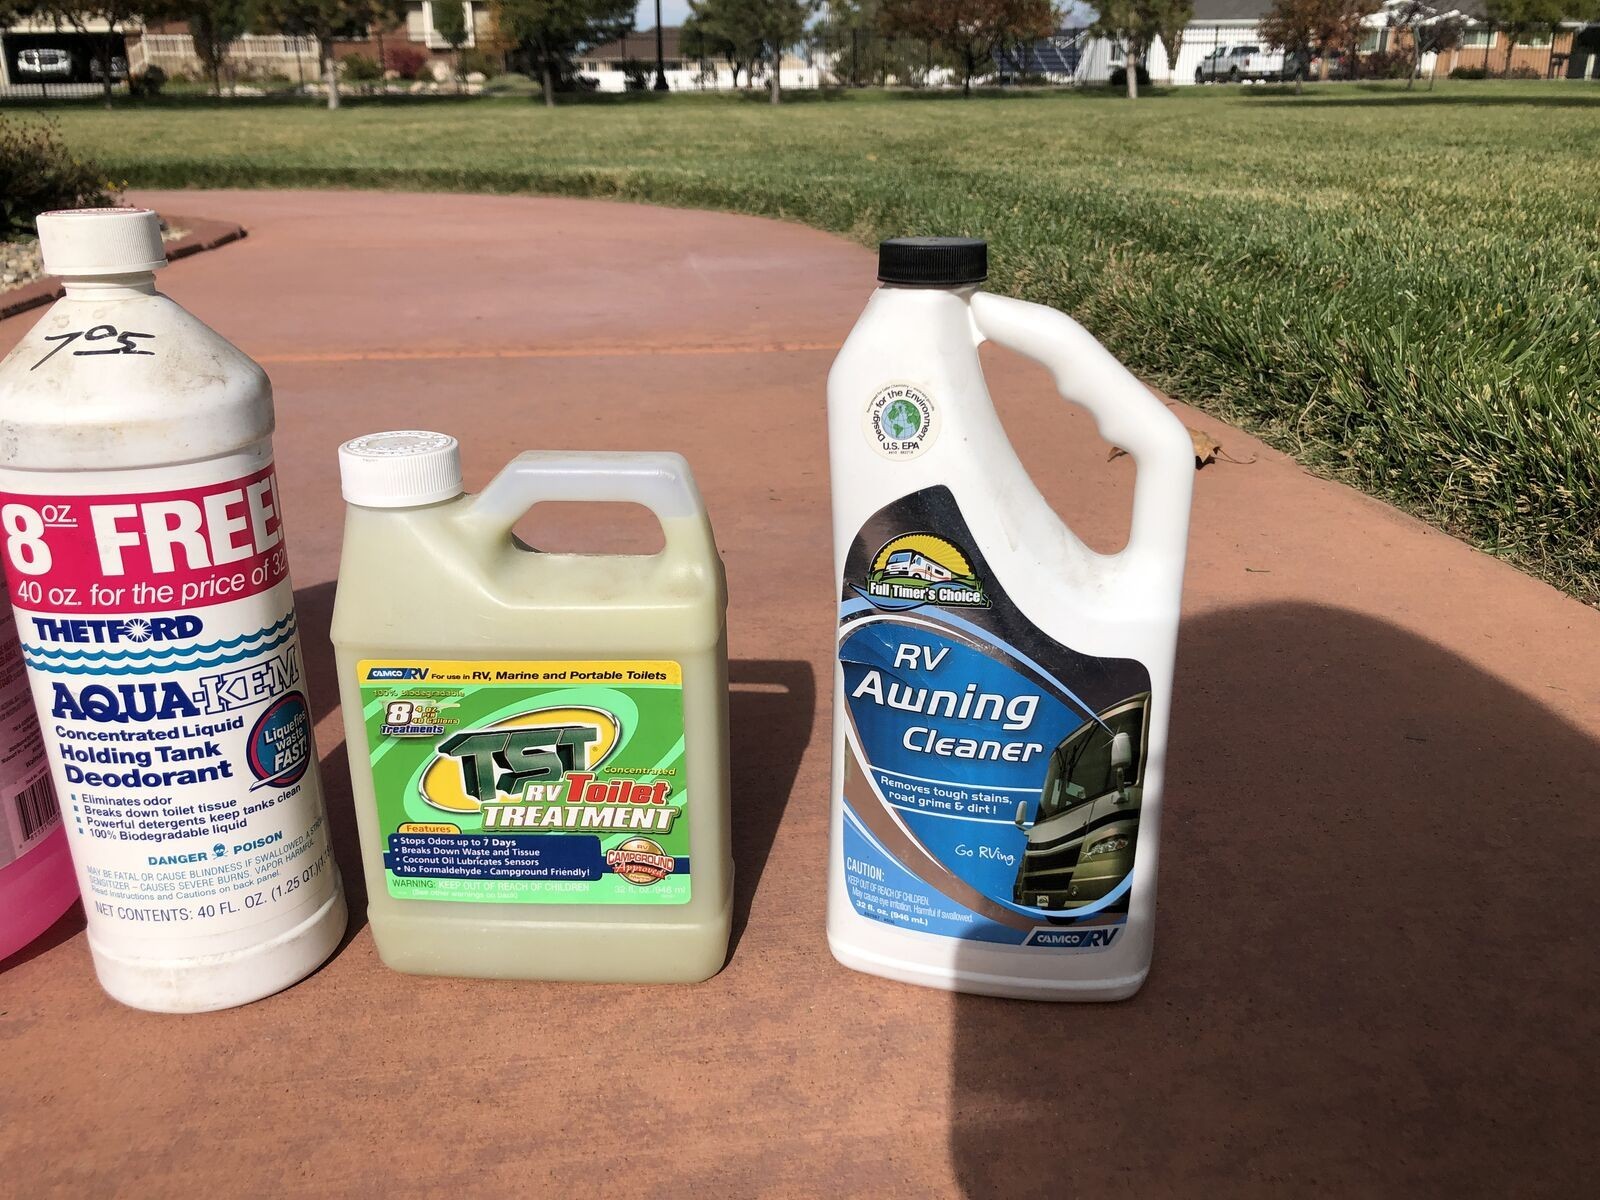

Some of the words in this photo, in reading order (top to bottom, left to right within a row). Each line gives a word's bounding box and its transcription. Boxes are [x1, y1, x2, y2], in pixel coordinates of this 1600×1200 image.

[876, 396, 887, 408] for
[887, 390, 903, 399] the
[871, 410, 886, 442] Design
[905, 389, 931, 442] Environment
[883, 442, 900, 450] U.S.
[902, 442, 919, 450] EPA
[1, 503, 53, 576] 8
[17, 580, 42, 604] 40
[48, 586, 82, 606] oz.
[90, 583, 125, 606] for
[132, 581, 174, 606] the
[181, 573, 245, 606] price
[251, 558, 269, 587] of
[870, 581, 890, 596] Full
[892, 584, 935, 601] Timer's
[938, 588, 981, 603] Choice
[32, 614, 203, 643] THETFORD
[893, 643, 950, 671] RV
[372, 669, 403, 677] CAMCO
[406, 668, 429, 680] RV
[472, 671, 492, 681] RV,
[495, 671, 539, 680] Marine
[542, 671, 566, 680] and
[570, 671, 622, 680] Portable
[626, 671, 667, 680] Toilets
[852, 670, 1040, 730] Awning
[386, 701, 414, 726] 8
[55, 724, 180, 742] Concentrated
[183, 716, 244, 739] Liquid
[264, 710, 306, 744] Liquefies
[381, 725, 444, 735] Treatments
[276, 727, 303, 752] waste
[902, 726, 1043, 763] Cleaner
[59, 742, 152, 767] Holding
[155, 741, 222, 763] Tank
[438, 726, 598, 801] TST
[64, 760, 233, 788] Deodorant
[603, 766, 676, 776] Concentrated
[81, 793, 141, 807] Eliminates
[143, 796, 172, 807] odor
[525, 784, 564, 801] RV
[566, 774, 669, 804] Toilet
[880, 776, 930, 795] Removes
[933, 786, 968, 802] tough
[971, 792, 1012, 805] stains,
[84, 804, 122, 818] Breaks
[125, 808, 158, 818] down
[162, 805, 195, 817] toilet
[198, 799, 237, 813] tissue
[86, 816, 135, 829] Powerful
[138, 815, 206, 830] detergents
[209, 809, 240, 823] keep
[243, 798, 275, 816] tanks
[277, 784, 301, 803] clean
[889, 791, 915, 804] road
[918, 797, 951, 810] grime
[954, 801, 965, 811] &
[967, 802, 990, 814] dirt
[406, 824, 451, 833] Features
[482, 806, 676, 830] TREATMENT
[89, 828, 117, 840] 100%
[119, 827, 209, 843] Biodegradable
[212, 818, 248, 834] liquid
[233, 830, 283, 855] POISON
[400, 837, 425, 846] Stops
[428, 837, 455, 846] Odors
[457, 839, 468, 847] up
[483, 838, 489, 846] 7
[492, 838, 516, 847] Days
[148, 852, 208, 866] DANGER
[401, 847, 431, 855] Breaks
[433, 847, 460, 855] Down
[463, 848, 490, 856] Waste
[492, 848, 510, 856] and
[512, 848, 540, 857] Tissue
[402, 856, 439, 864] Coconut
[441, 856, 454, 865] Oil
[457, 857, 502, 866] Lubricates
[504, 858, 539, 866] Sensors
[607, 851, 674, 871] CAMPGROUND
[955, 844, 973, 857] Go
[103, 870, 112, 879] BE
[114, 871, 139, 881] FATAL
[141, 872, 154, 882] OR
[156, 871, 187, 882] CAUSE
[189, 862, 242, 879] BLINDNESS
[140, 882, 176, 892] CAUSES
[178, 878, 215, 890] SEVERE
[255, 858, 284, 875] VAPOR
[403, 865, 417, 873] No
[419, 865, 482, 875] Formaldehyde
[489, 868, 548, 877] Campground
[550, 867, 590, 877] Friendly!
[614, 862, 664, 877] Approved
[846, 856, 885, 882] CAUTION:
[110, 889, 154, 901] Instructions
[157, 892, 173, 900] and
[176, 889, 216, 900] Cautions
[233, 878, 254, 890] back
[392, 879, 436, 889] WARNING:
[438, 881, 461, 889] KEEP
[464, 882, 481, 890] OUT
[484, 882, 495, 890] OF
[498, 882, 528, 891] REACH
[531, 883, 542, 891] OF
[544, 883, 589, 892] CHILDREN
[847, 874, 859, 886] KEEP
[860, 879, 869, 890] OUT
[870, 882, 877, 892] OF
[877, 885, 894, 898] REACH
[894, 890, 902, 899] OF
[95, 901, 113, 917] NET
[117, 907, 194, 922] CONTENTS:
[198, 904, 215, 918] 40
[220, 901, 240, 914] FL.
[245, 892, 267, 909] OZ.
[271, 875, 300, 902] (1.25
[856, 900, 866, 908] 32
[890, 910, 909, 921] (946
[1037, 934, 1080, 944] CAMCO
[1086, 928, 1119, 947] RV
